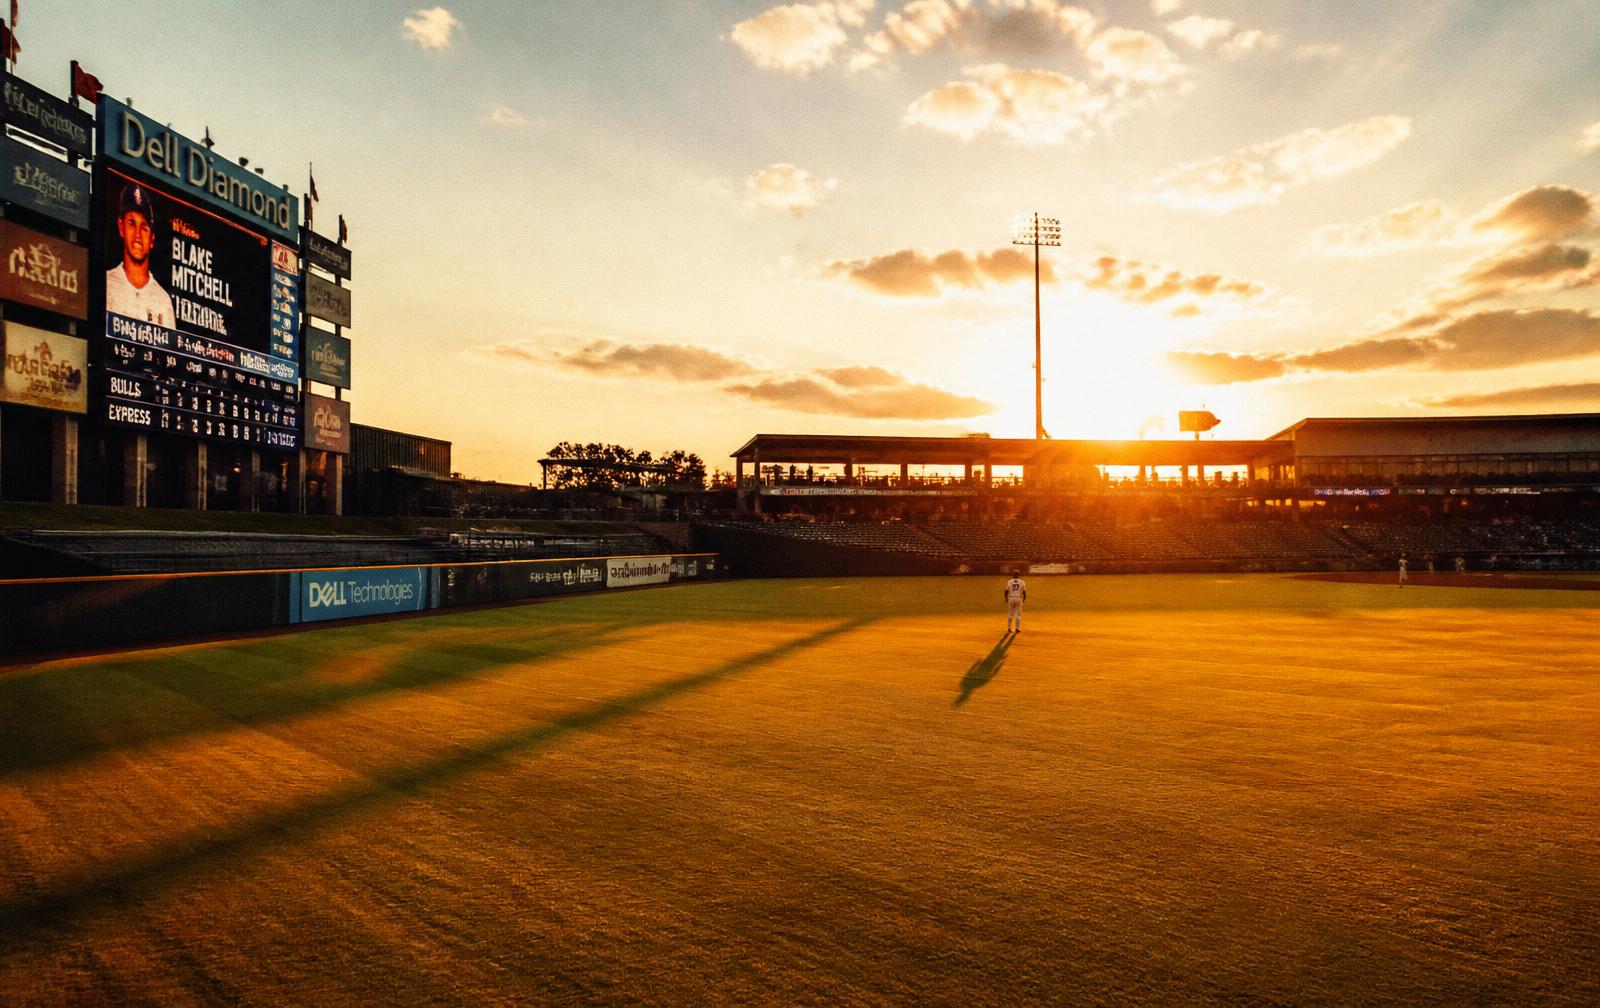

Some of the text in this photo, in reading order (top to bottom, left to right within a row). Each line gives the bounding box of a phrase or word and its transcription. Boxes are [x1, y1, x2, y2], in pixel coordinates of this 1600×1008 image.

[123, 110, 181, 178] Dell
[187, 145, 290, 231] Diamond
[172, 237, 213, 275] BLAKE
[171, 264, 233, 307] MITCHELL
[110, 376, 142, 398] BULLS
[309, 579, 413, 607] DELL Technologies
